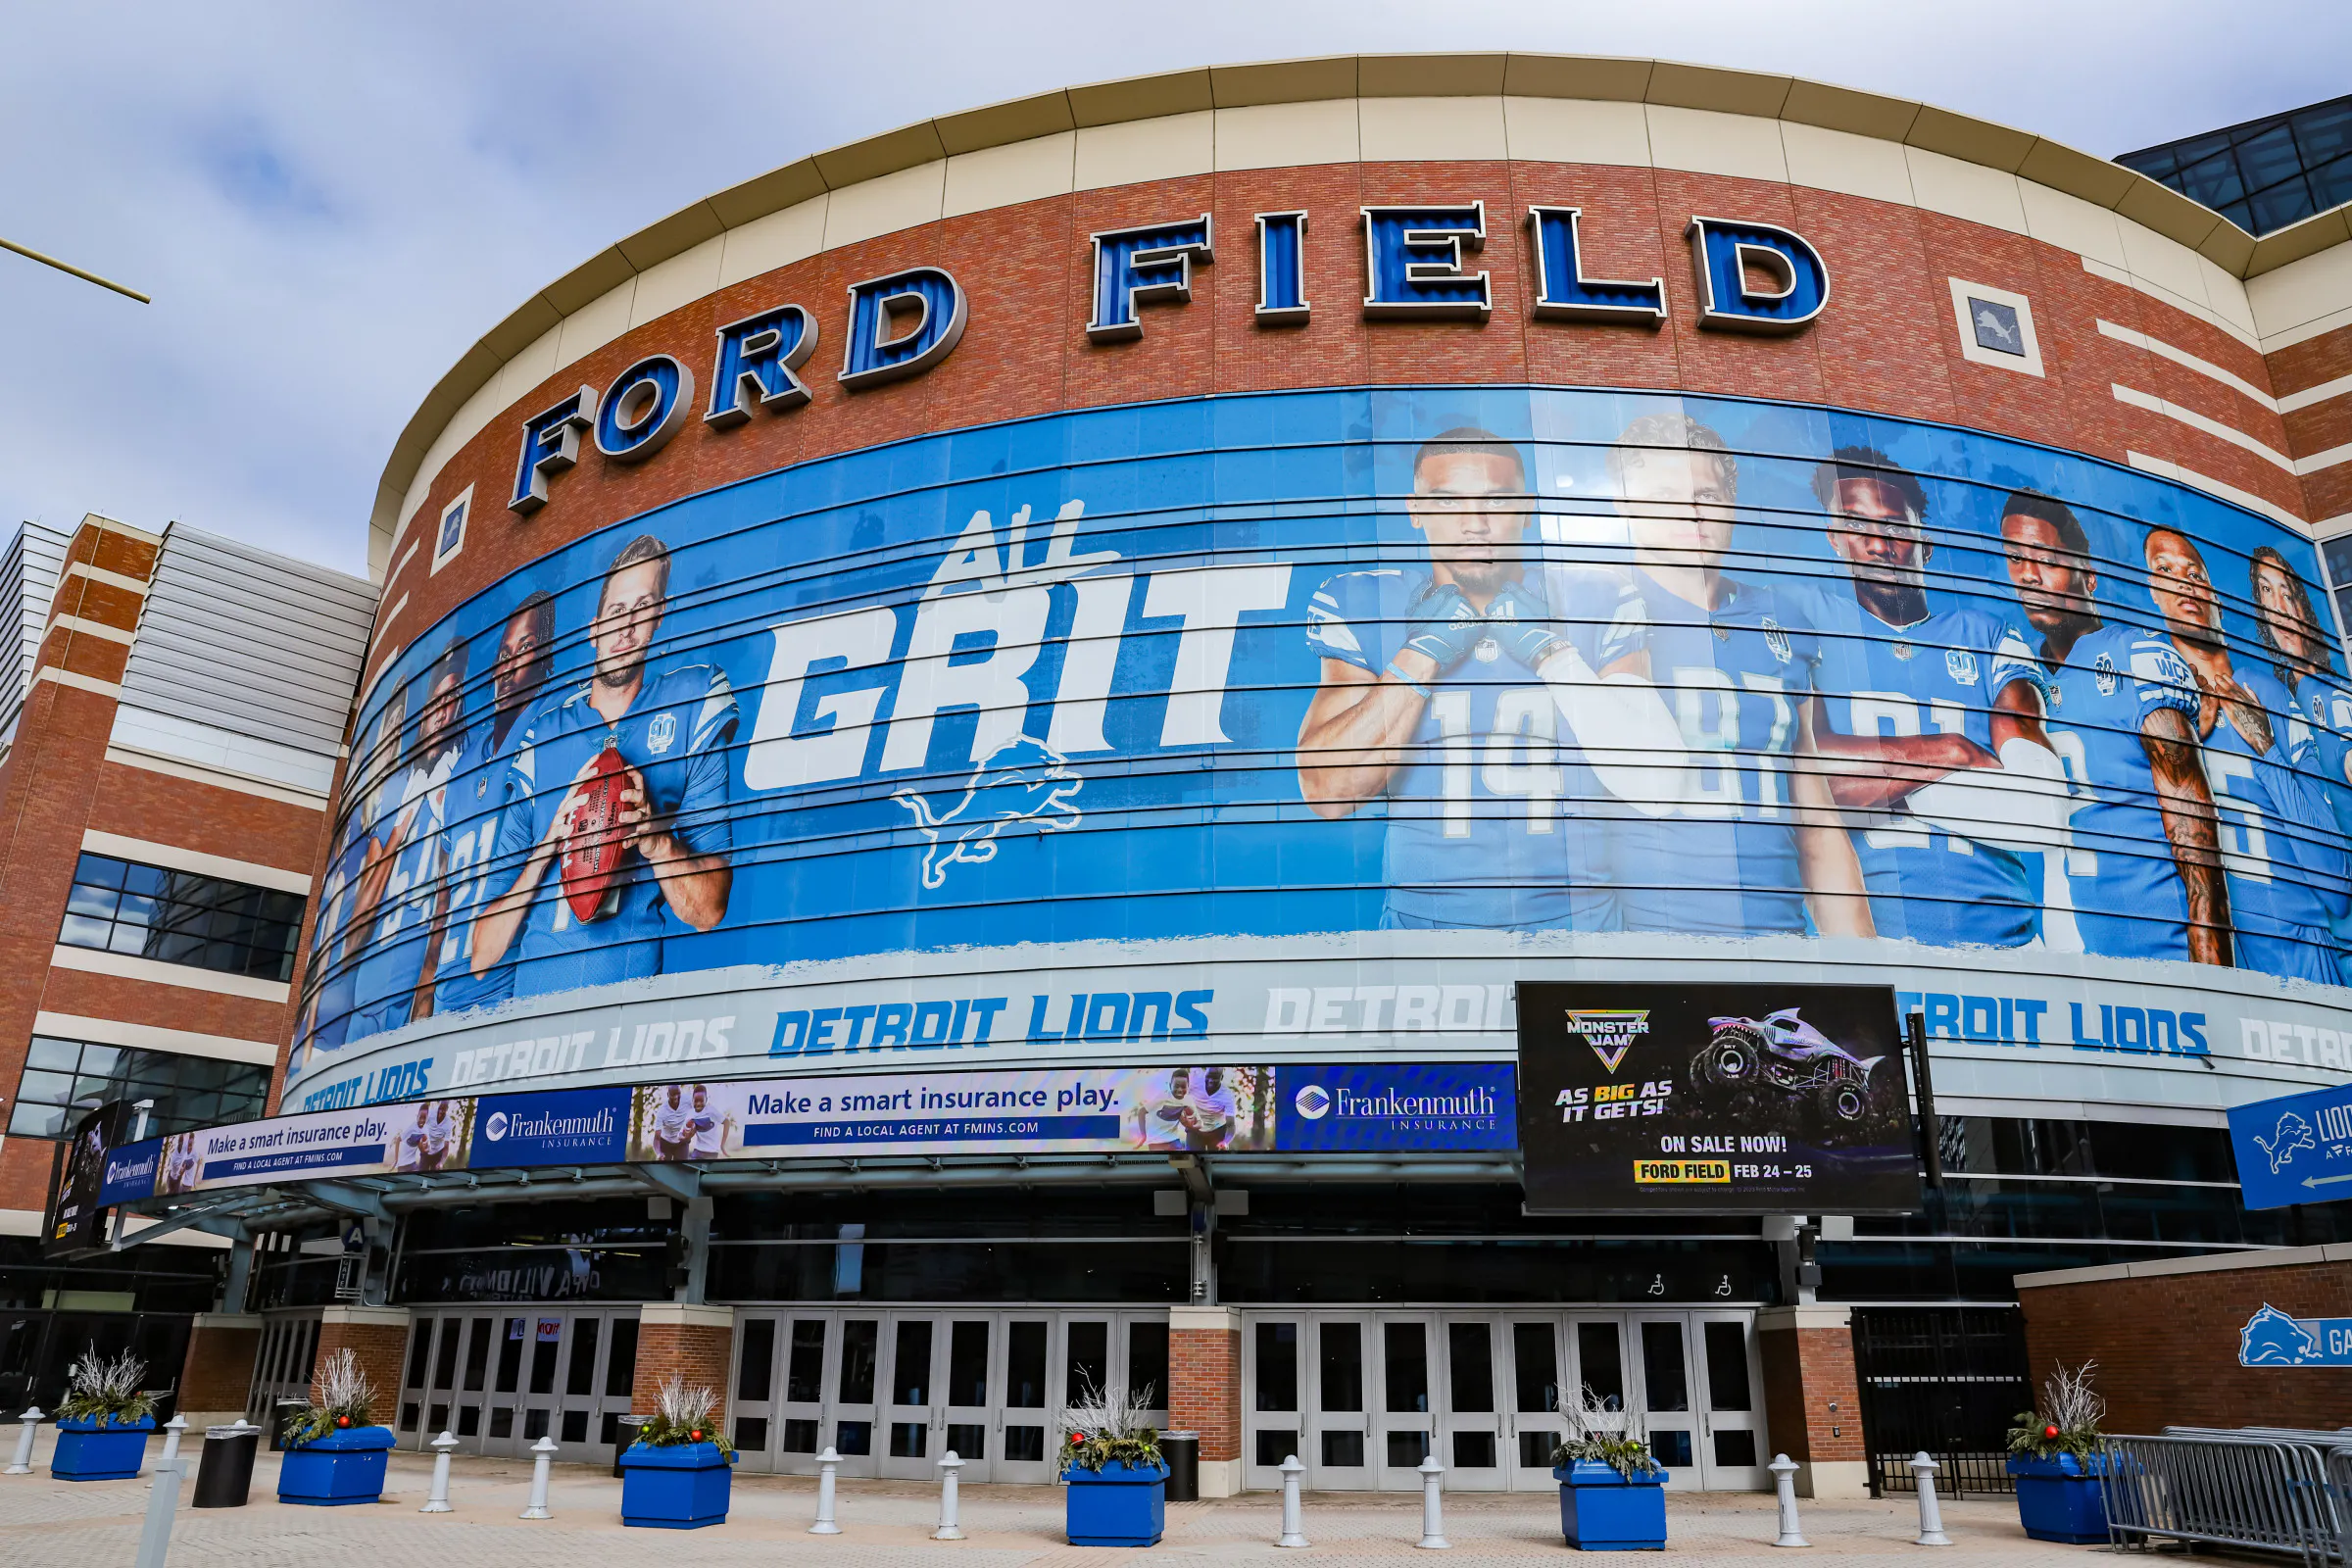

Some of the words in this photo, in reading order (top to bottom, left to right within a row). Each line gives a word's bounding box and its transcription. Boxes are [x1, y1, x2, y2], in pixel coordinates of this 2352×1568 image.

[507, 266, 968, 514] FORD
[1086, 200, 1831, 343] FIELD
[917, 499, 1121, 612] ALL
[744, 562, 1293, 790] GRIT
[1946, 651, 1976, 675] 90
[2155, 658, 2190, 683] WCF
[650, 716, 676, 741] 90
[1672, 666, 1793, 817] 87
[1431, 686, 1563, 839] 14
[439, 817, 498, 965] 21
[768, 997, 1008, 1060] DETROIT
[1025, 989, 1215, 1047] LIONS
[1263, 984, 1516, 1040] DETROI
[1567, 1021, 1649, 1034] MONSTER
[1591, 1034, 1628, 1047] JAM
[2068, 1002, 2212, 1059] LIONS
[447, 1030, 596, 1096] DETROIT
[602, 1015, 736, 1073] LIONS
[303, 1076, 364, 1112] DETROIT
[361, 1057, 434, 1105] LIONS
[748, 1091, 811, 1115] Make
[817, 1095, 832, 1112] a
[840, 1088, 912, 1112] smart
[920, 1086, 1048, 1109] insurance
[1056, 1082, 1120, 1112] play.
[1554, 1088, 1589, 1106] AS
[1593, 1083, 1636, 1102] BIG
[1639, 1080, 1673, 1099] AS
[1336, 1086, 1494, 1116] Frankenmuth
[1562, 1105, 1590, 1123] IT
[1593, 1098, 1665, 1120] GETS!
[208, 1134, 235, 1155] Make
[238, 1137, 246, 1151] a
[249, 1128, 284, 1150] smart
[287, 1126, 351, 1146] insurance
[353, 1117, 388, 1144] play.
[510, 1107, 613, 1138] Frankenmuth
[813, 1126, 841, 1138] FIND
[845, 1125, 854, 1137] A
[857, 1125, 895, 1137] LOCAL
[899, 1123, 941, 1136] AGENT
[944, 1123, 958, 1135] AT
[963, 1121, 1039, 1134] FMINS.COM
[1392, 1119, 1496, 1130] INSURANCE
[542, 1136, 612, 1149] INSURANCE
[1660, 1136, 1686, 1152] ON
[1690, 1136, 1735, 1152] SALE
[1740, 1136, 1788, 1153] NOW!
[233, 1160, 247, 1171] FIND
[247, 1160, 253, 1170] A
[253, 1158, 271, 1169] LOCAL
[272, 1156, 294, 1167] AGENT
[295, 1154, 303, 1165] AT
[304, 1151, 343, 1164] FMINS.COM
[1641, 1163, 1680, 1179] FORD
[1684, 1163, 1725, 1179] FIELD
[1734, 1164, 1759, 1178] FEB
[1762, 1164, 1781, 1178] 24
[1794, 1164, 1812, 1178] 25
[348, 1226, 364, 1245] A
[339, 1258, 349, 1288] GATE
